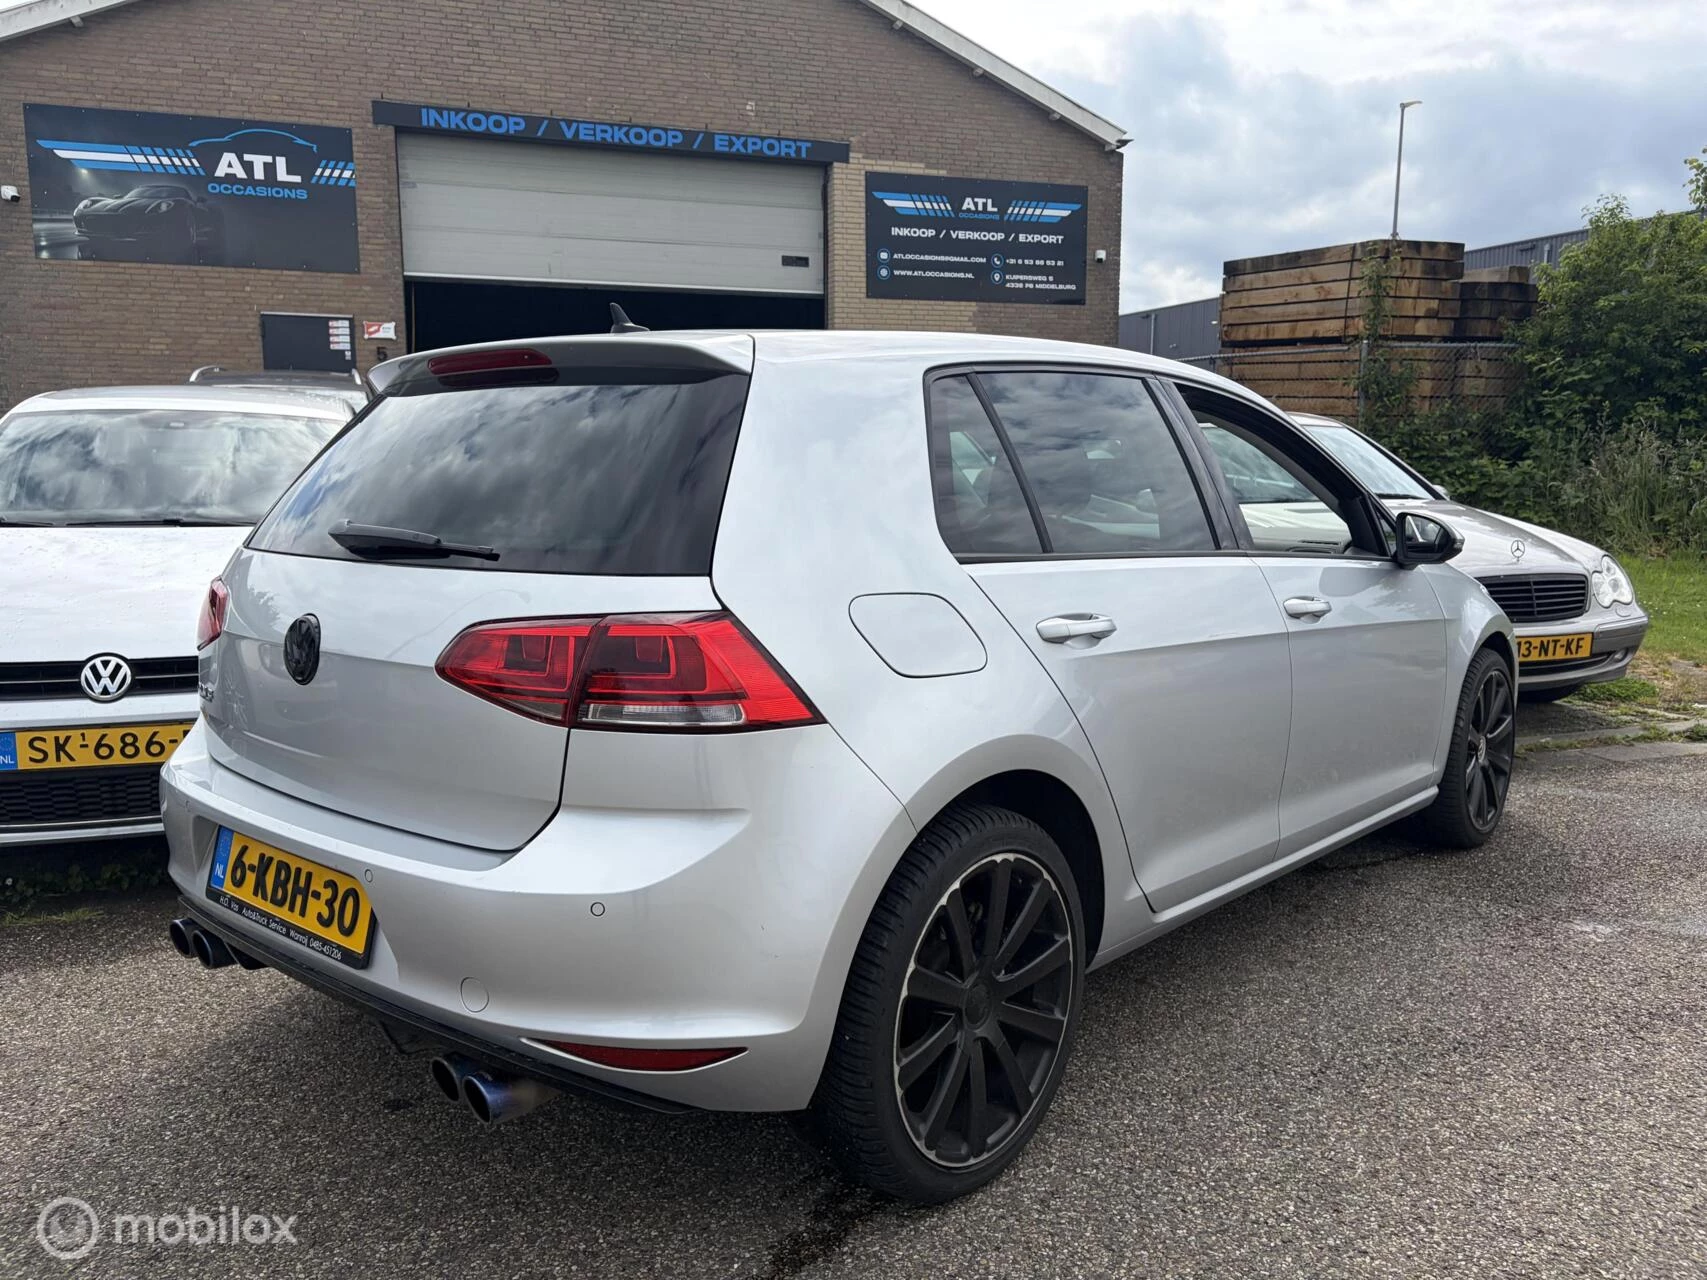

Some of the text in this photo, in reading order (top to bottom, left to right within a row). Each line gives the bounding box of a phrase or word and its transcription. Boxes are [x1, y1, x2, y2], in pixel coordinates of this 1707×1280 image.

[420, 107, 812, 159] INKOOP / VERKOOP / EXPORT
[214, 151, 302, 183] ATL
[207, 182, 308, 200] OCCASIONS
[961, 197, 998, 212] ATL
[891, 227, 936, 238] INKOOP
[950, 230, 1005, 241] VERKOOP
[1018, 234, 1064, 244] EXPORT
[893, 270, 975, 279] WWW.ATLOCCASIONS.NL
[376, 346, 388, 361] 5
[1516, 637, 1585, 658] 13-NT-KF
[214, 862, 224, 879] NL
[230, 845, 360, 938] 6-KBH-30
[268, 918, 287, 935] Service
